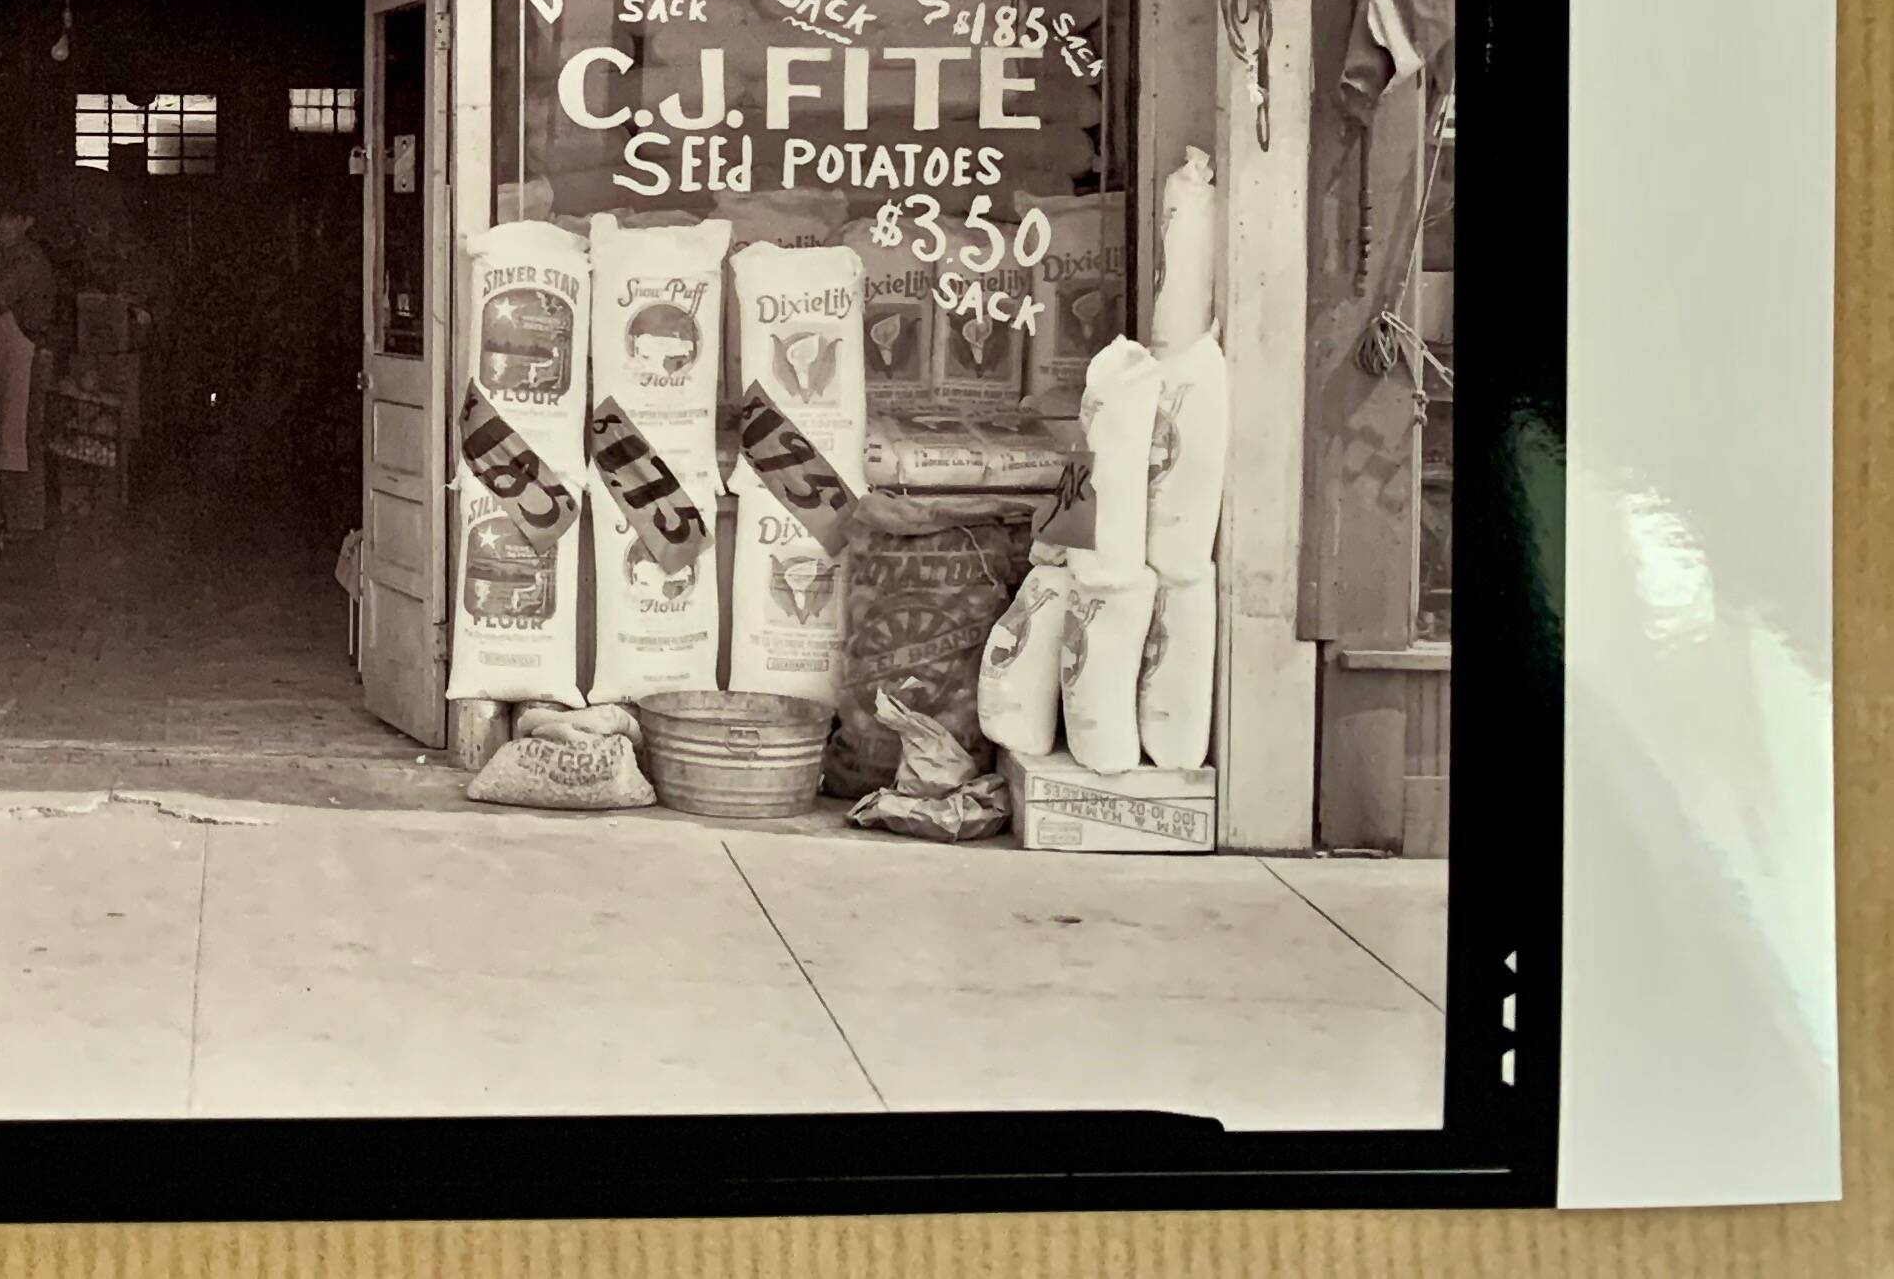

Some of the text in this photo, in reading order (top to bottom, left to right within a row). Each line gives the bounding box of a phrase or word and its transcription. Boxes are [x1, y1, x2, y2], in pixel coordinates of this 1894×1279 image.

[1054, 13, 1105, 78] SACK
[557, 47, 1043, 131] C.J. FITE
[782, 138, 1004, 189] POTATOES
[870, 194, 1051, 272] $3.50
[483, 266, 580, 305] SILVER STAR
[618, 278, 709, 318] Snow Puff
[932, 272, 1045, 335] SACK
[489, 389, 560, 407] FLOUR
[639, 372, 687, 388] Flour
[473, 615, 543, 631] FLOUR
[639, 598, 691, 614] Flour
[1157, 820, 1194, 839] ARM
